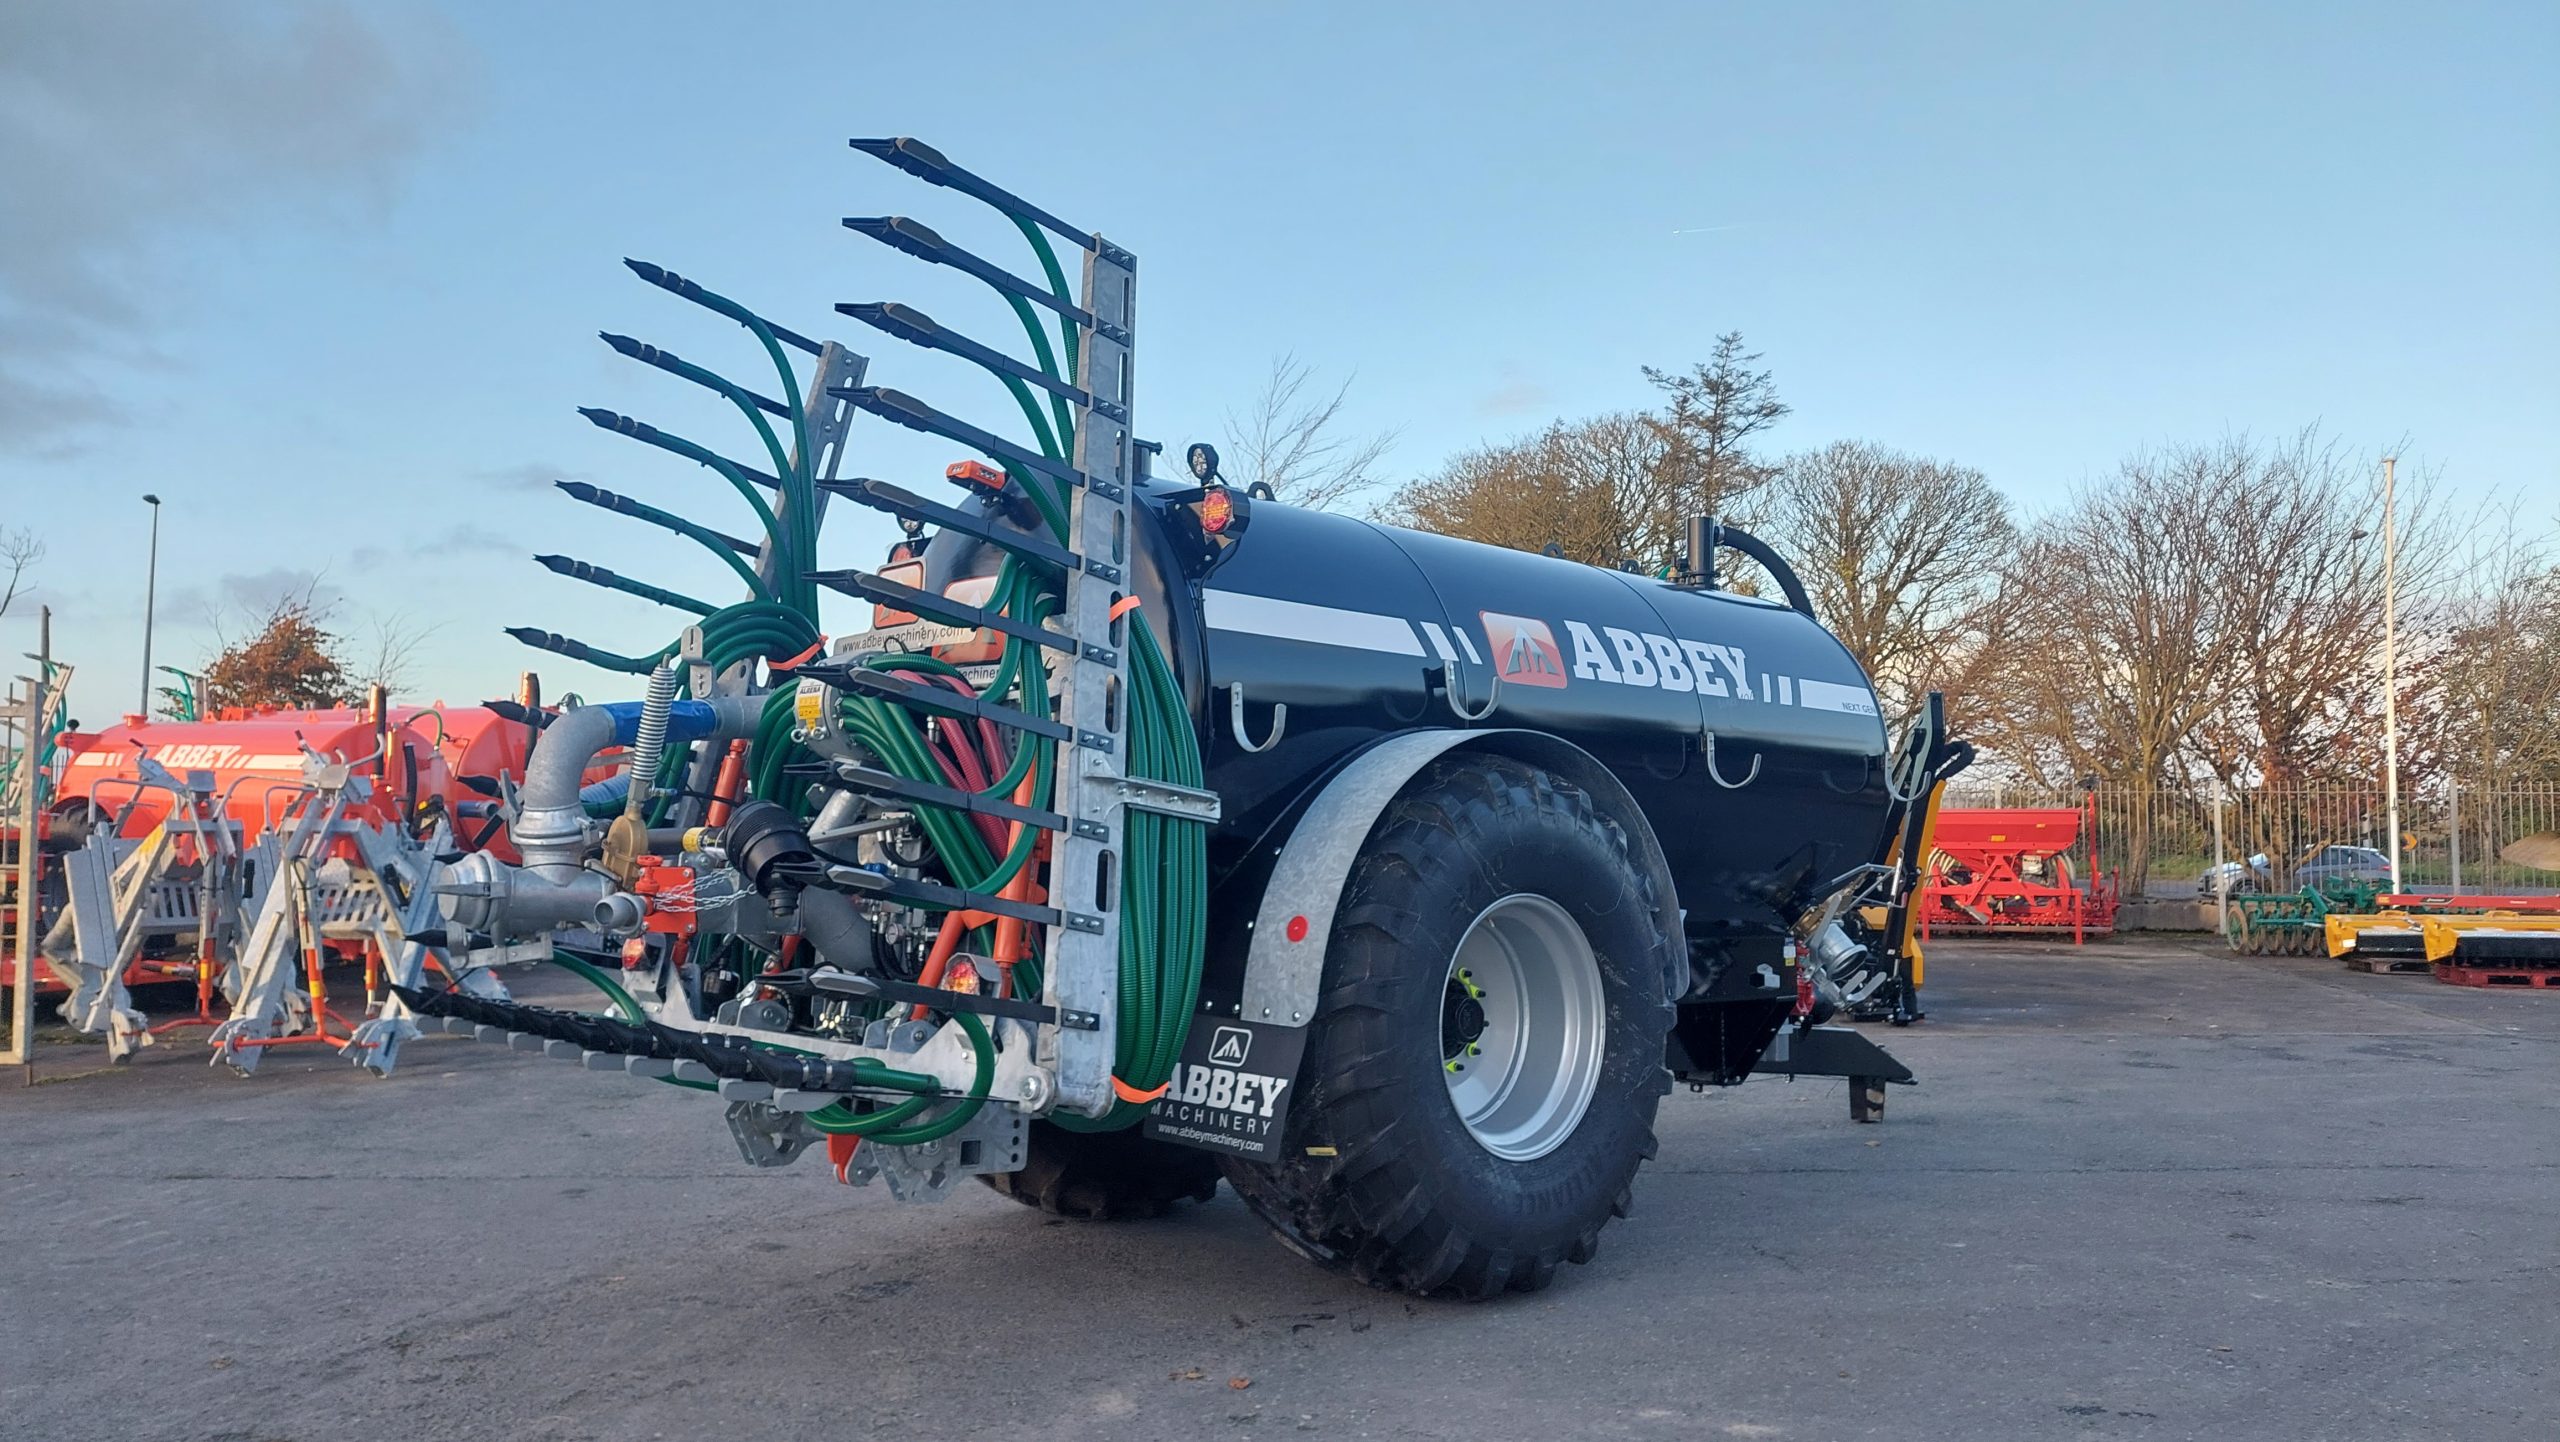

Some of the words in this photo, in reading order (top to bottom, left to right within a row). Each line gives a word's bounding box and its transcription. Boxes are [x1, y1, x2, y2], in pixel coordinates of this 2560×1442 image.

[1563, 620, 1755, 701] ABBEY
[1842, 702, 1860, 712] NEXT
[154, 744, 242, 769] ABBEY
[1160, 1062, 1289, 1118] ABBEY
[1150, 1102, 1272, 1136] MACHINERY
[1158, 1123, 1264, 1152] www.abbeymachinery.com
